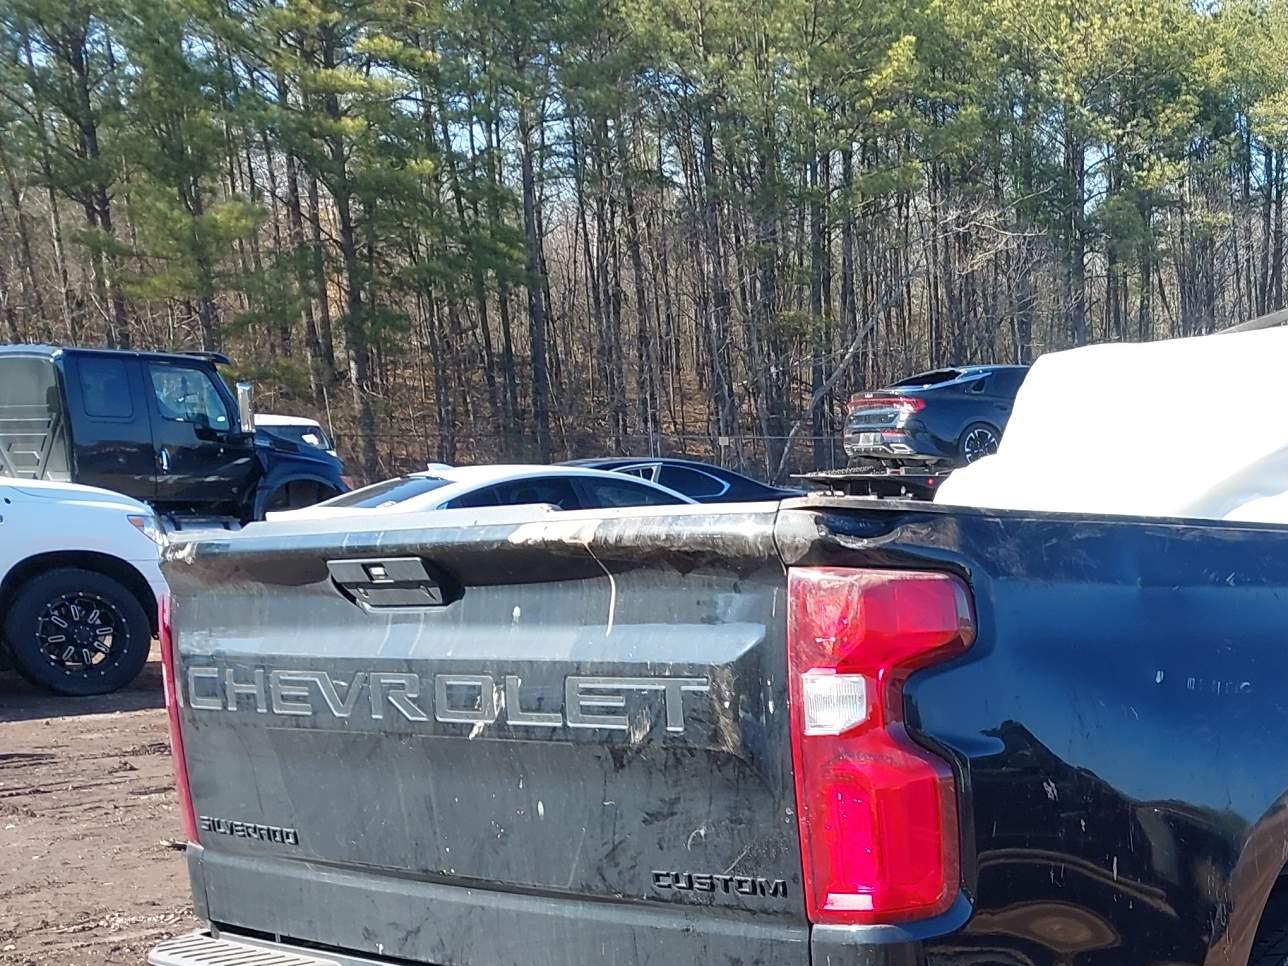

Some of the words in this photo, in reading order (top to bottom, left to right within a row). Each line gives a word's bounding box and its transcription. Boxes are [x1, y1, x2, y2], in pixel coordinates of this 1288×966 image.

[189, 667, 711, 732] CHEVROLET
[200, 815, 299, 846] SILVERADO
[650, 870, 788, 898] CUSTOM
